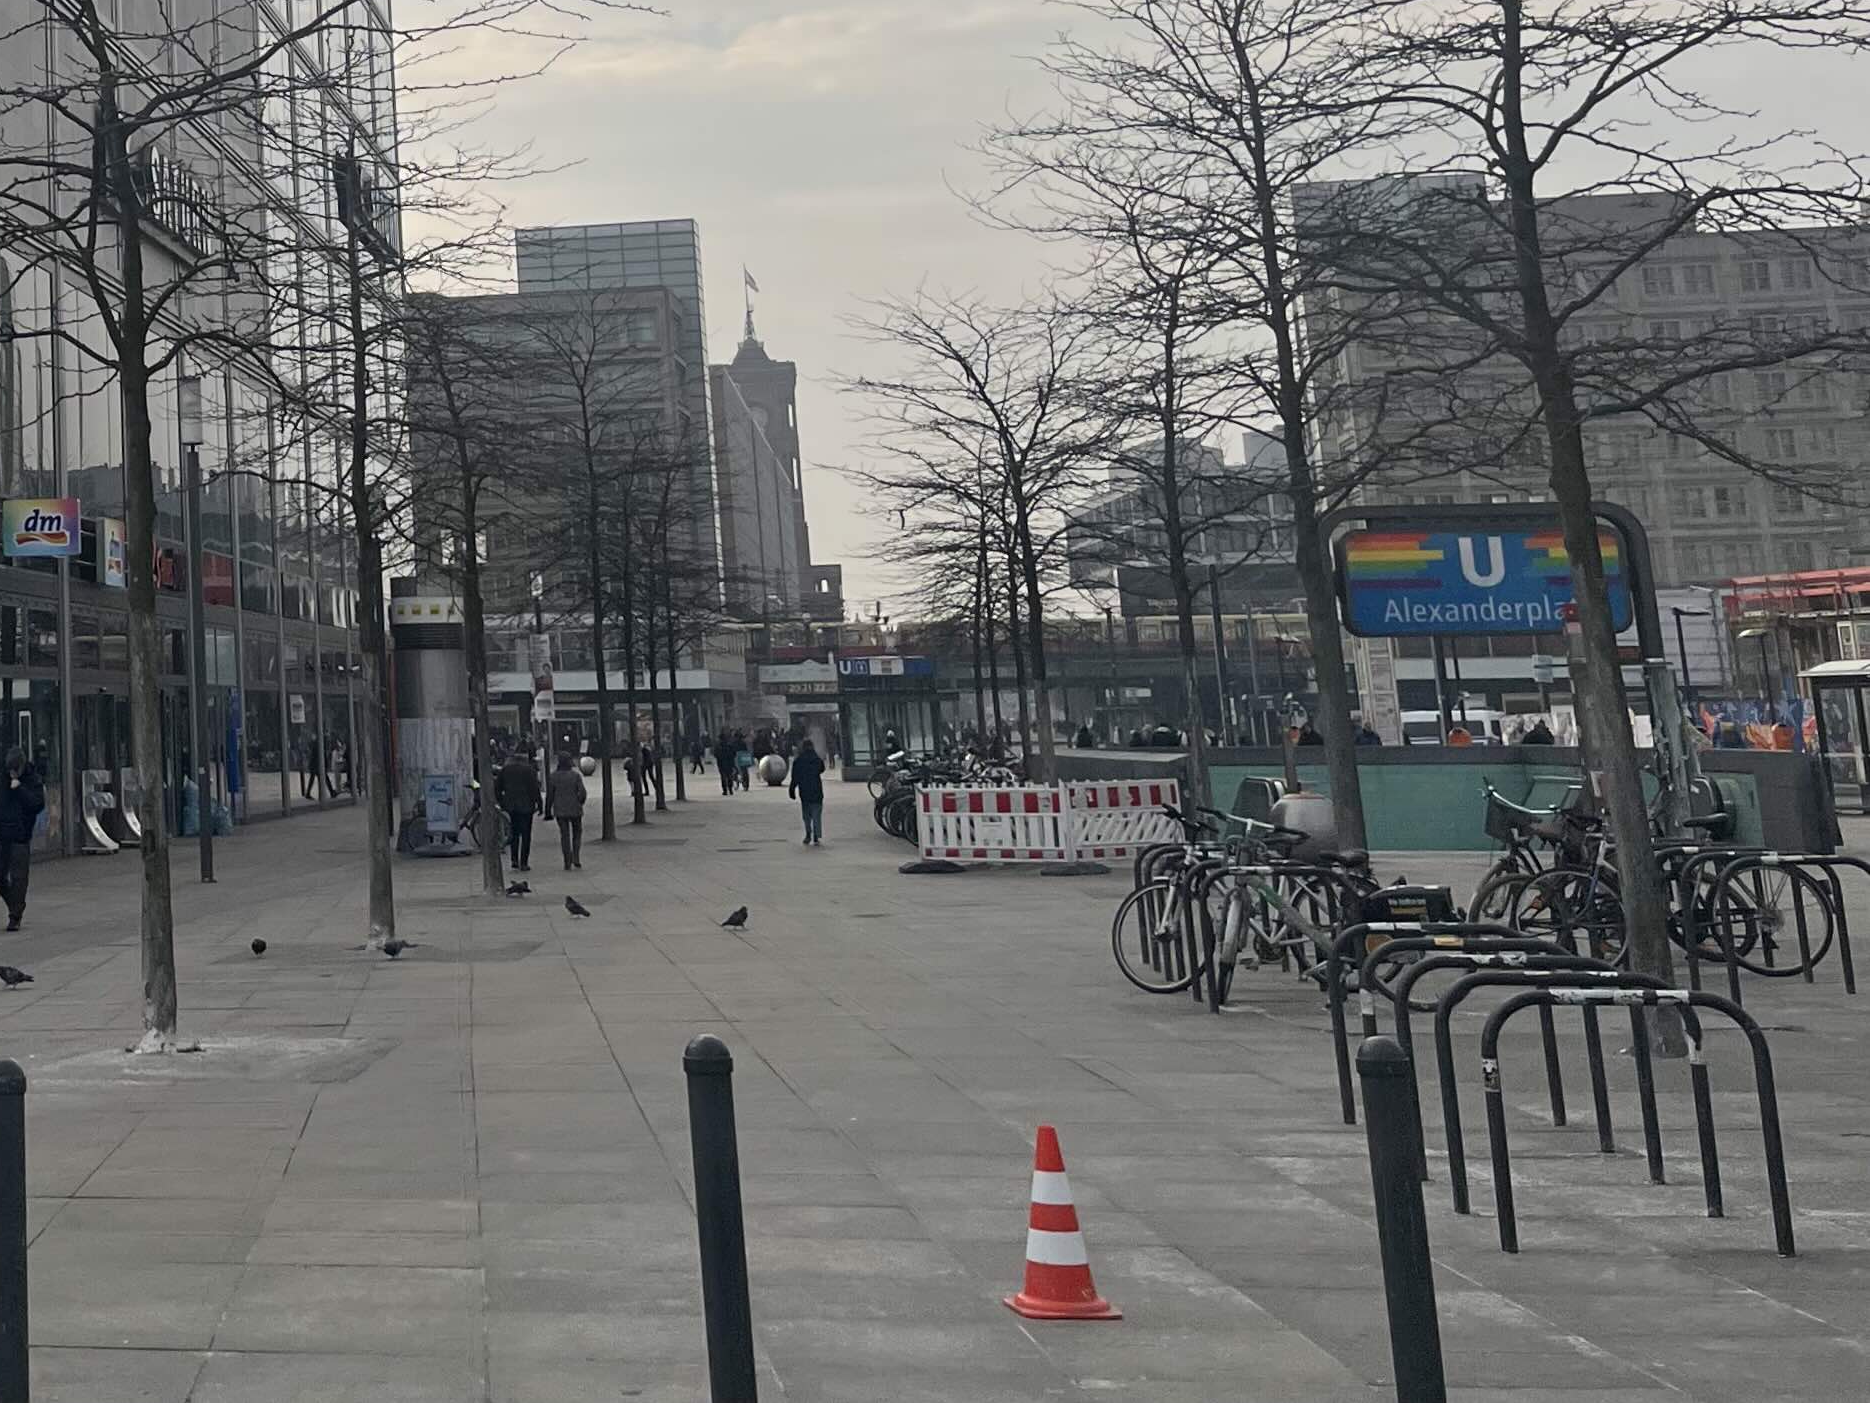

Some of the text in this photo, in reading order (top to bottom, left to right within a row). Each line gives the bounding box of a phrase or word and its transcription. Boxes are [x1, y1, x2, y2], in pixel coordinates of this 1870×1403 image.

[24, 509, 62, 532] dm
[1458, 537, 1505, 587] U
[1384, 595, 1565, 627] Alexanderpla
[839, 660, 851, 674] U
